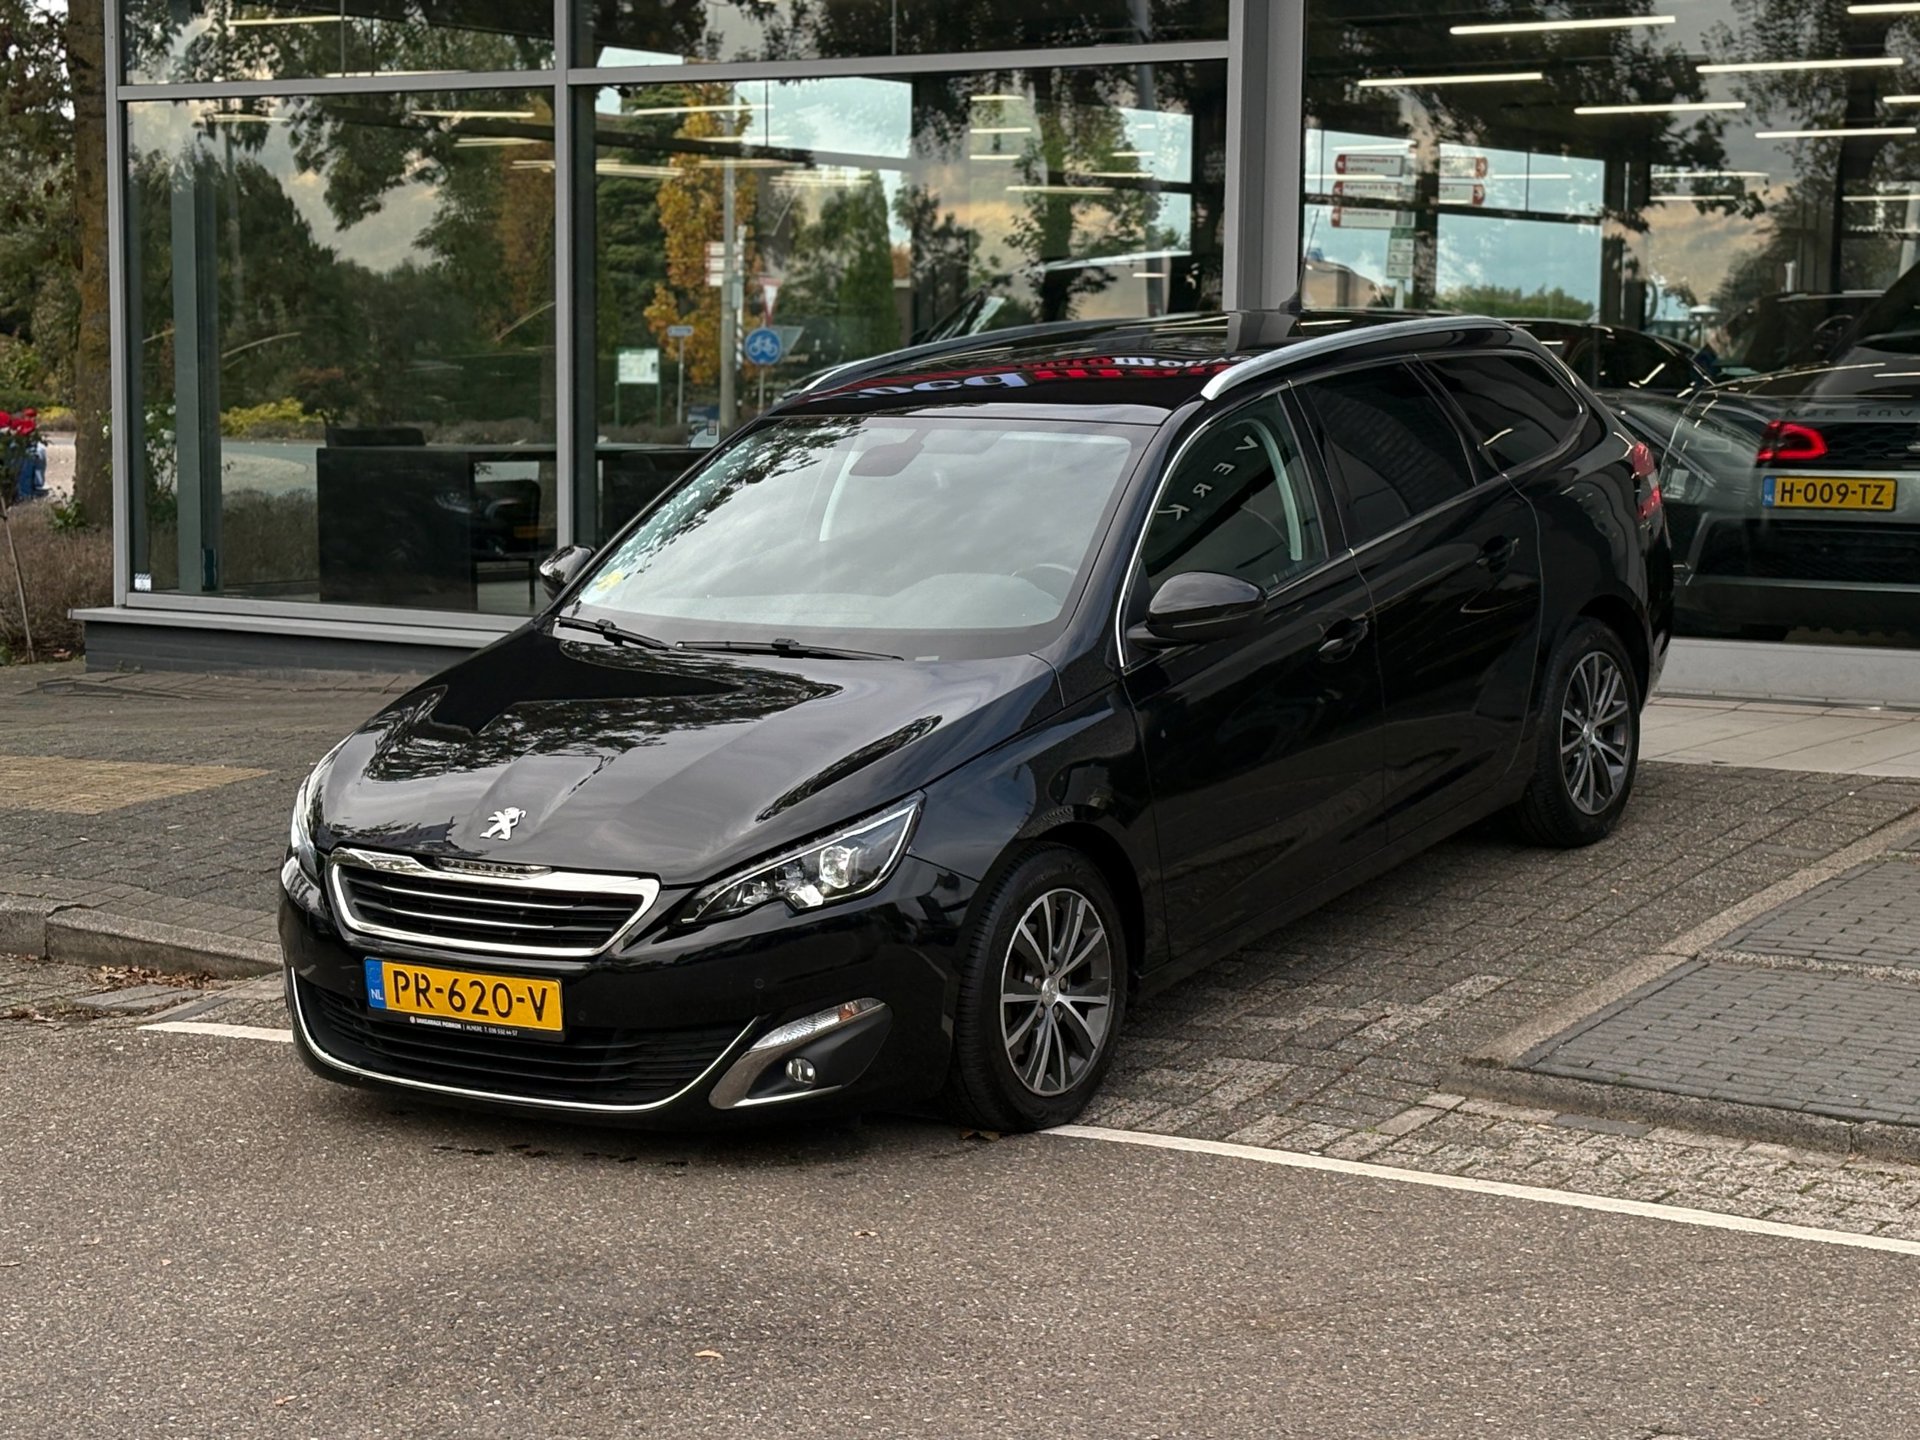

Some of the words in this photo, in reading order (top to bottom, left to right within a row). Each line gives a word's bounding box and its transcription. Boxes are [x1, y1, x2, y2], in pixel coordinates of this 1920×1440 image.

[1780, 481, 1886, 506] H-009-TZ
[370, 988, 384, 1001] NL
[393, 970, 547, 1022] PR-620-V
